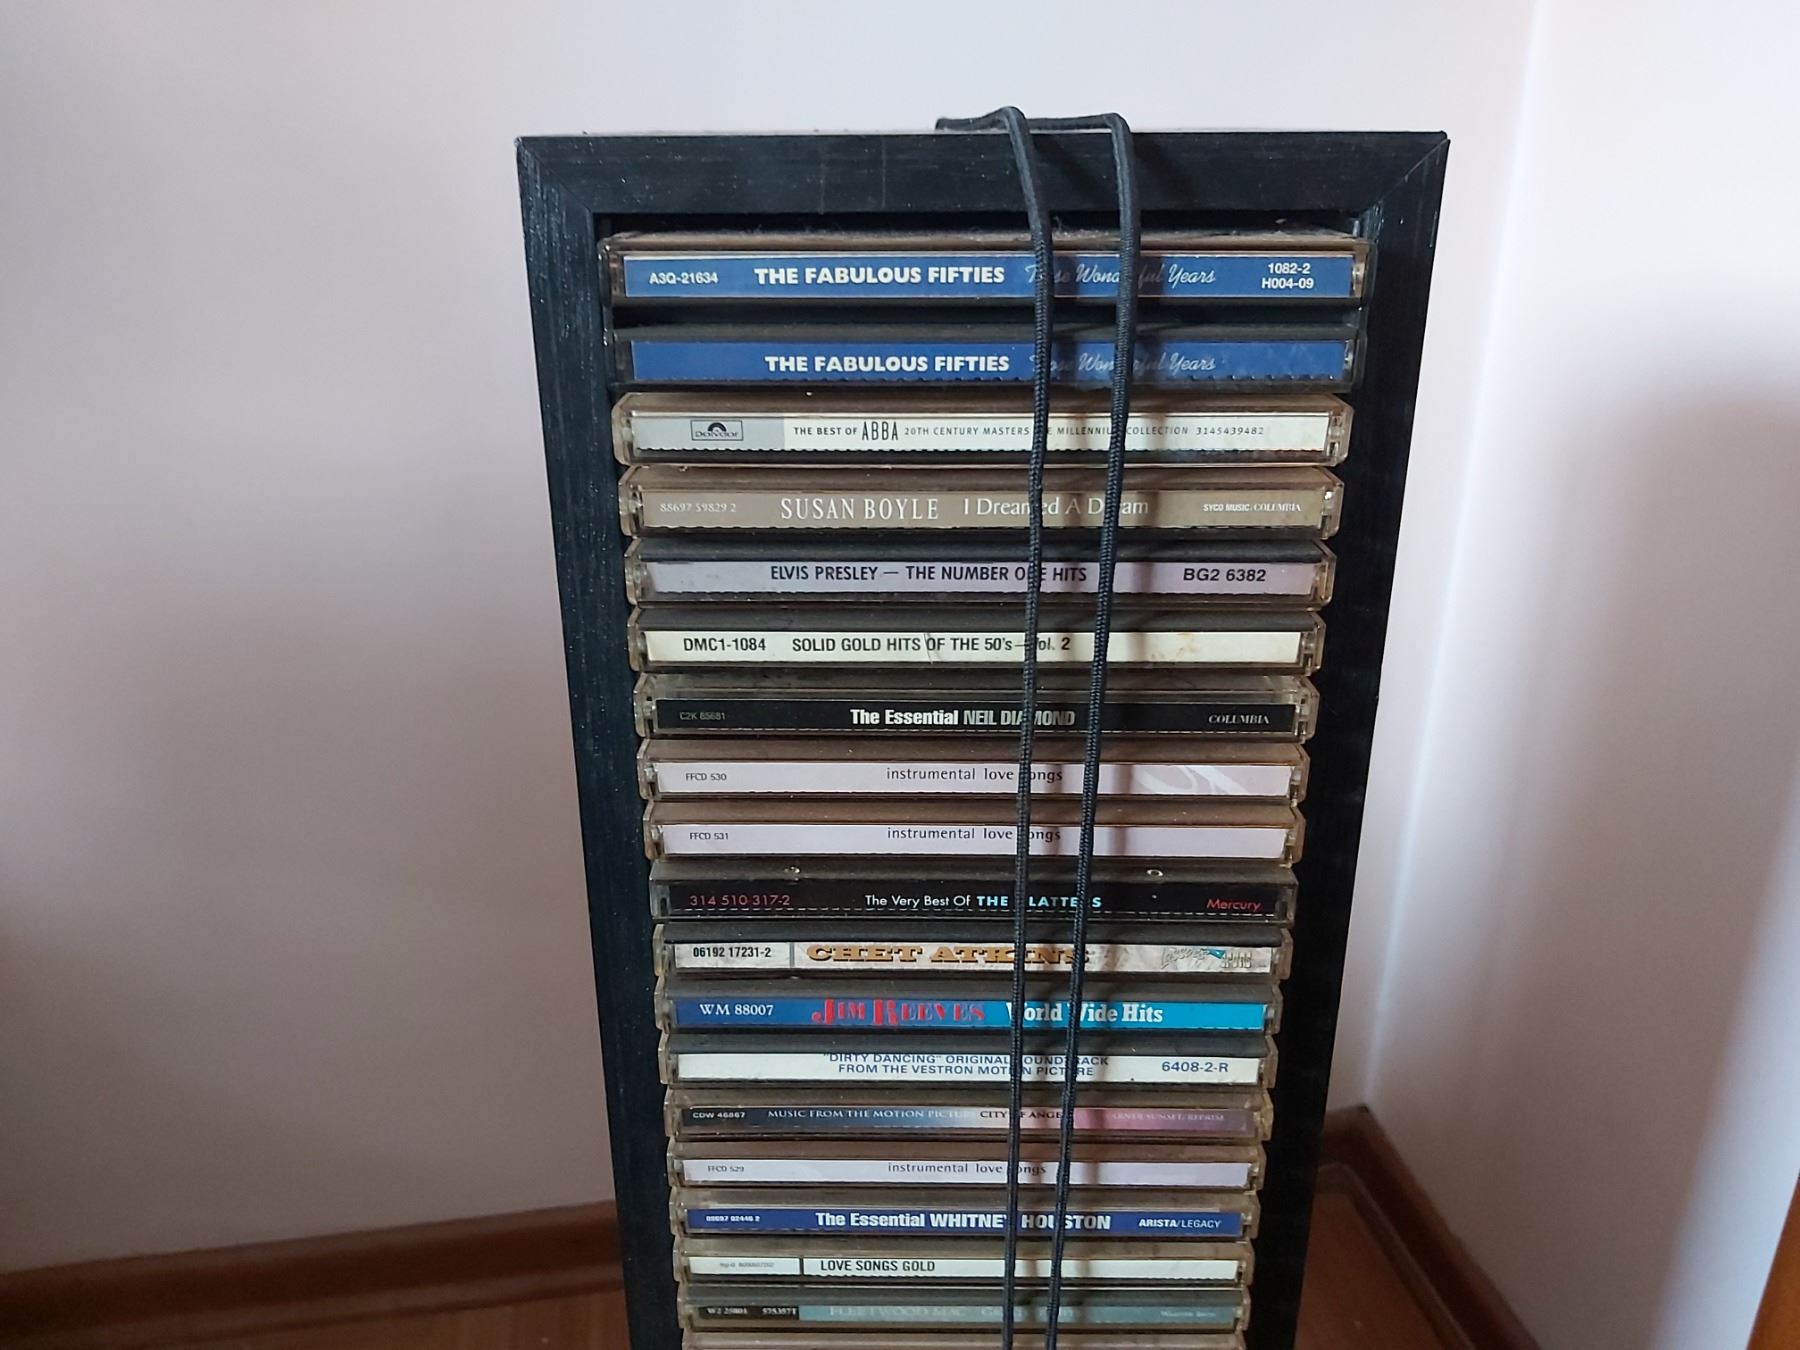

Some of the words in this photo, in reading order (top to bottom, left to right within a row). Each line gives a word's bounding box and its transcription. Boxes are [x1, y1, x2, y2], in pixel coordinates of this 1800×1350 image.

[1267, 263, 1310, 274] 1082-2
[754, 268, 798, 284] THE
[805, 268, 921, 284] FABULOUS
[928, 267, 1005, 283] FIFTIES
[1024, 264, 1070, 284] Tse
[1167, 263, 1215, 288] Years
[1261, 277, 1314, 290] H004-09
[765, 356, 807, 371] THE
[814, 356, 928, 372] FABULOUS
[934, 356, 1009, 371] FIFTIES
[1168, 352, 1215, 377] Years
[793, 426, 812, 435] THE
[817, 426, 843, 435] BEST
[848, 426, 857, 435] OF
[861, 421, 899, 441] ABBA
[904, 427, 930, 436] 20TH
[933, 426, 979, 436] CENTURY
[983, 426, 1029, 435] MASTERS
[1057, 425, 1121, 436] MILLENNI
[1126, 426, 1188, 435] COLLECTION
[730, 503, 737, 513] 2
[780, 498, 855, 520] SUSAN
[863, 498, 939, 520] BOYLE
[963, 499, 969, 515] I
[1065, 499, 1081, 514] A
[1087, 498, 1148, 515] Dam
[1203, 503, 1224, 512] SYCO
[1225, 503, 1250, 512] MUSIC
[771, 565, 809, 581] ELVIS
[814, 565, 878, 581] PRESLEY
[905, 566, 936, 580] THE
[941, 565, 1009, 581] NUMBER
[1014, 566, 1047, 581] OE
[1052, 566, 1088, 582] HITS
[1183, 567, 1220, 582] BG2
[1225, 568, 1267, 583] 6382
[683, 637, 767, 653] DMC1-1084
[792, 638, 837, 653] SOLID
[841, 638, 882, 653] GOLD
[886, 638, 922, 652] HITS
[926, 638, 946, 652] OF
[950, 638, 980, 652] THE
[1036, 637, 1057, 651] ol.
[1061, 637, 1071, 650] 2
[850, 708, 880, 725] The
[885, 709, 959, 725] Essential
[963, 709, 997, 726] NEIL
[1208, 714, 1270, 725] COLUMBIA
[685, 773, 708, 782] FFCD
[710, 773, 727, 782] 530
[886, 766, 976, 781] instrumental
[984, 767, 1014, 780] love
[1029, 770, 1063, 784] ongs
[689, 832, 711, 840] FFCD
[887, 826, 975, 840] instrumental
[983, 826, 1013, 839] love
[1027, 830, 1062, 843] ongs
[689, 895, 717, 906] 314
[721, 894, 749, 906] 510
[752, 895, 790, 906] 317-2
[865, 895, 888, 907] The
[891, 895, 920, 910] Very
[923, 895, 950, 907] Best
[953, 894, 971, 907] Of
[976, 895, 1009, 907] THE
[1016, 896, 1102, 908] LATTES
[1207, 898, 1261, 912] Mercury
[693, 947, 726, 958] 06192
[729, 946, 771, 958] 17231-2
[806, 945, 923, 963] CHET
[931, 946, 1090, 964] ATKN
[700, 1004, 731, 1017] WM
[734, 1004, 775, 1017] 88007
[811, 999, 868, 1025] JIM
[872, 999, 985, 1025] REEVES
[1005, 1003, 1062, 1023] orld
[1121, 1004, 1163, 1023] Hits
[945, 1055, 1009, 1065] ORIGINAL
[1014, 1056, 1109, 1066] OUNDACK
[1161, 1061, 1229, 1073] 6408-2-R
[838, 1064, 878, 1074] FROM
[883, 1064, 907, 1074] THE
[911, 1065, 974, 1075] VESTRON
[977, 1065, 1032, 1075] MOTIN
[1036, 1067, 1094, 1076] PICTRE
[767, 1110, 806, 1118] MUSIC
[810, 1110, 844, 1118] FROM
[848, 1110, 870, 1118] THE
[873, 1110, 924, 1118] MOTION
[927, 1110, 972, 1118] PICTU
[980, 1110, 1006, 1118] CITY
[1028, 1111, 1070, 1119] ANGE
[888, 1163, 968, 1174] instrumental
[976, 1163, 1002, 1173] love
[1016, 1166, 1046, 1176] ongs
[816, 1212, 845, 1226] The
[851, 1213, 924, 1226] Essential
[930, 1213, 1009, 1227] WHITNE
[820, 1260, 852, 1272] LOVE
[856, 1260, 898, 1272] SONGS
[903, 1260, 935, 1272] GOLD
